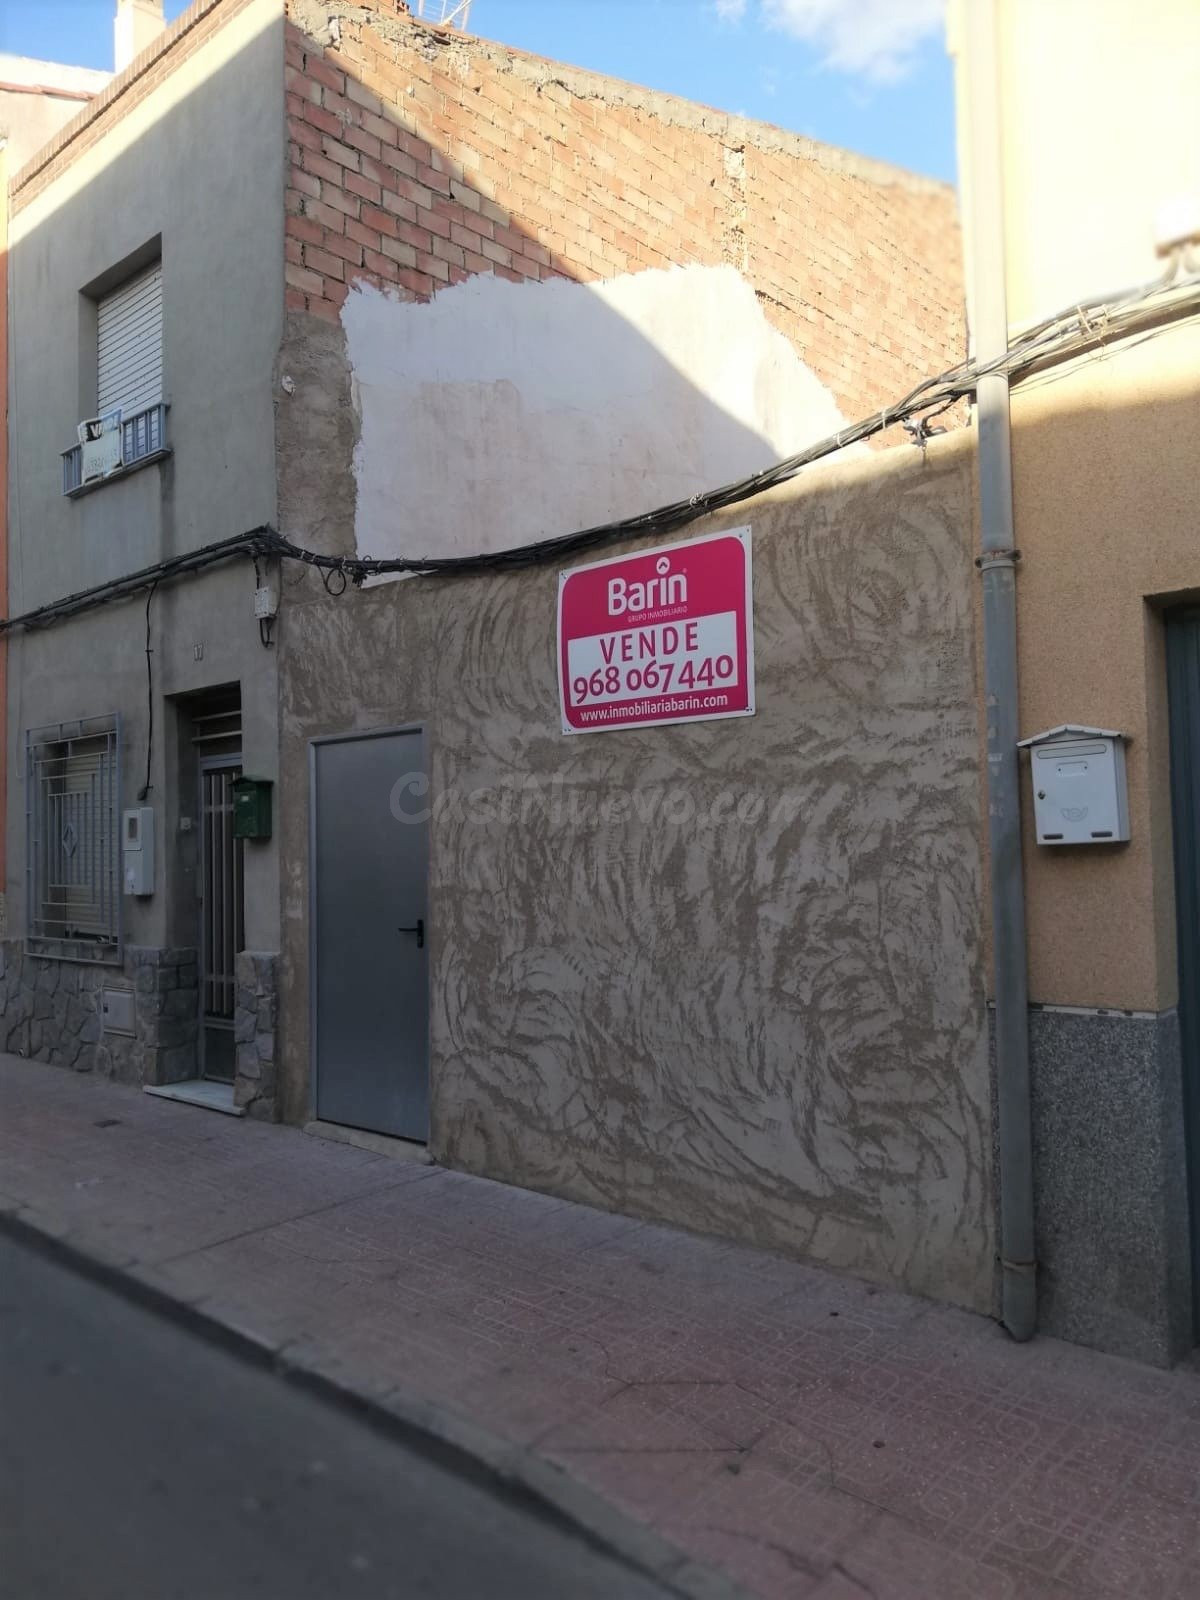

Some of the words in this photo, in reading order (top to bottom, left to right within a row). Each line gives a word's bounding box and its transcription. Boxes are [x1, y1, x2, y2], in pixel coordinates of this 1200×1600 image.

[608, 557, 688, 616] Barin
[600, 622, 699, 665] VENDE
[573, 666, 621, 704] 968
[580, 694, 728, 721] www.inmobiliariabarin.com
